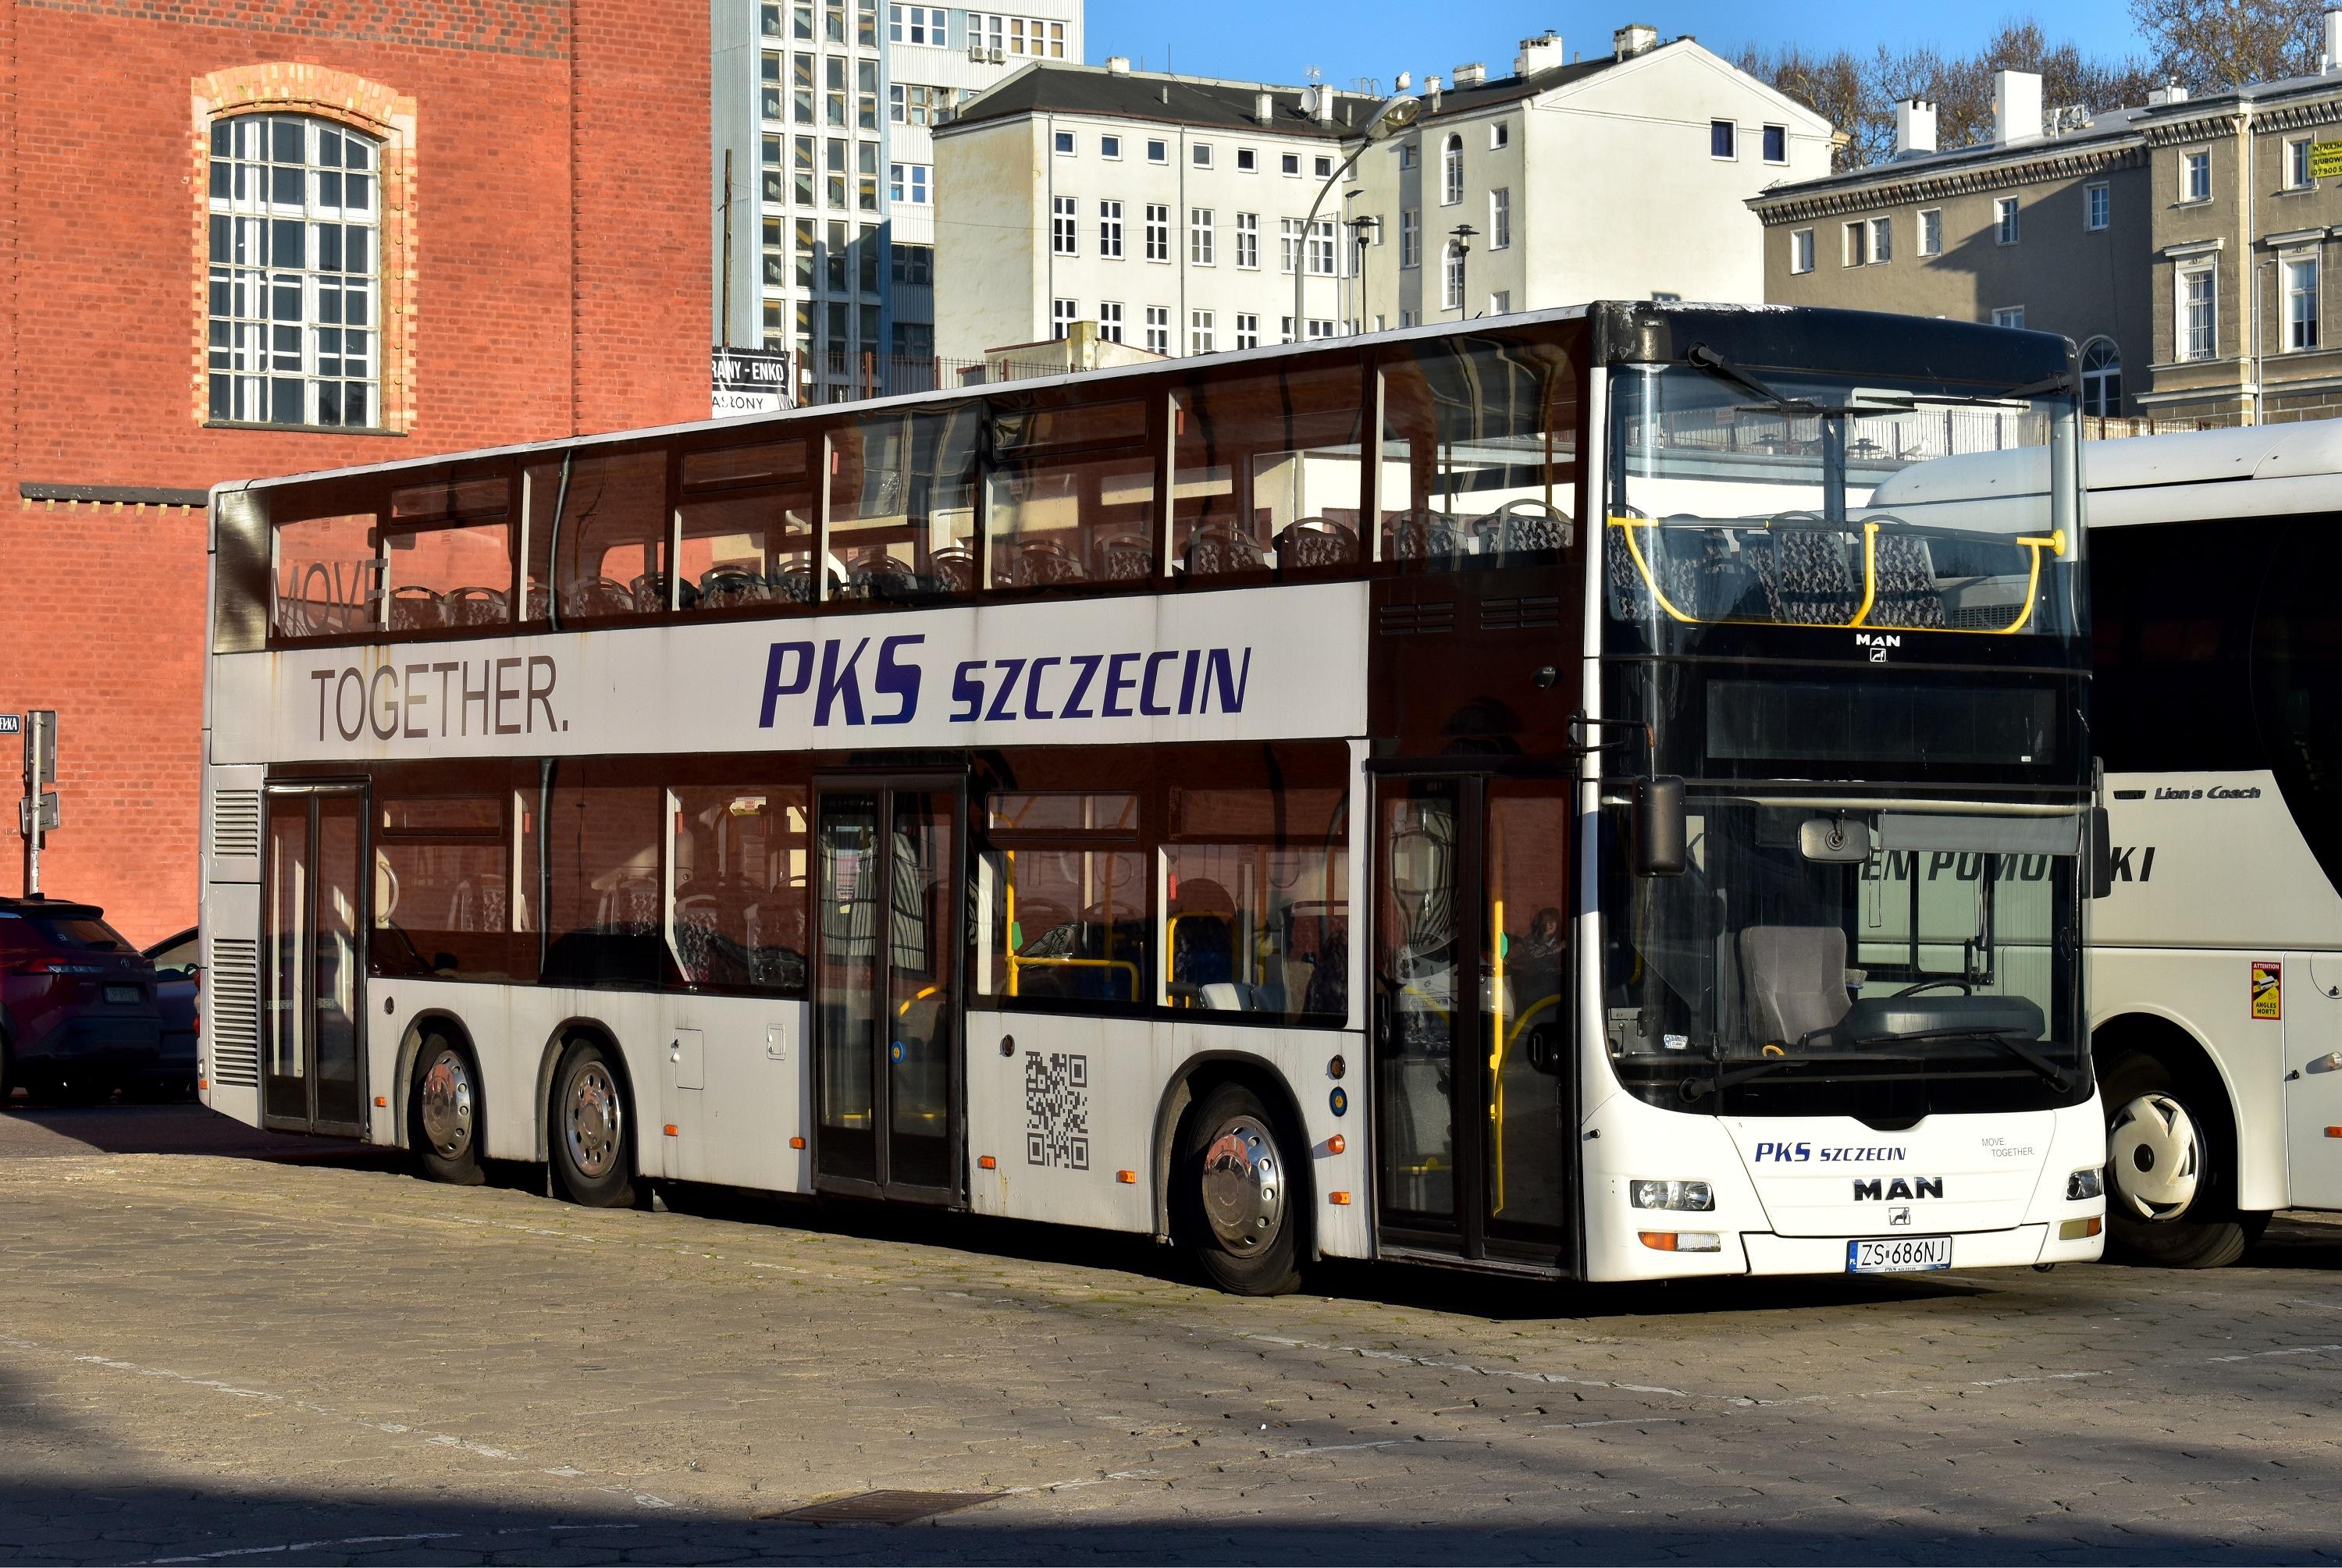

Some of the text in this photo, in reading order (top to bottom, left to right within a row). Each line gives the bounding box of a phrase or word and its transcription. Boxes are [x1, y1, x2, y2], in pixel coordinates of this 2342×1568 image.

[2313, 156, 2342, 165] BIUROW
[752, 362, 785, 381] ENKO
[1856, 633, 1901, 647] MAN
[759, 634, 1252, 728] PKS SZCZECIN
[311, 655, 568, 741] TOGETHER.
[2207, 785, 2261, 799] Coach
[1755, 1142, 1906, 1162] PKS SZCZECIN
[1991, 1147, 2035, 1157] TOGETHER.
[1853, 1176, 1943, 1201] MAN
